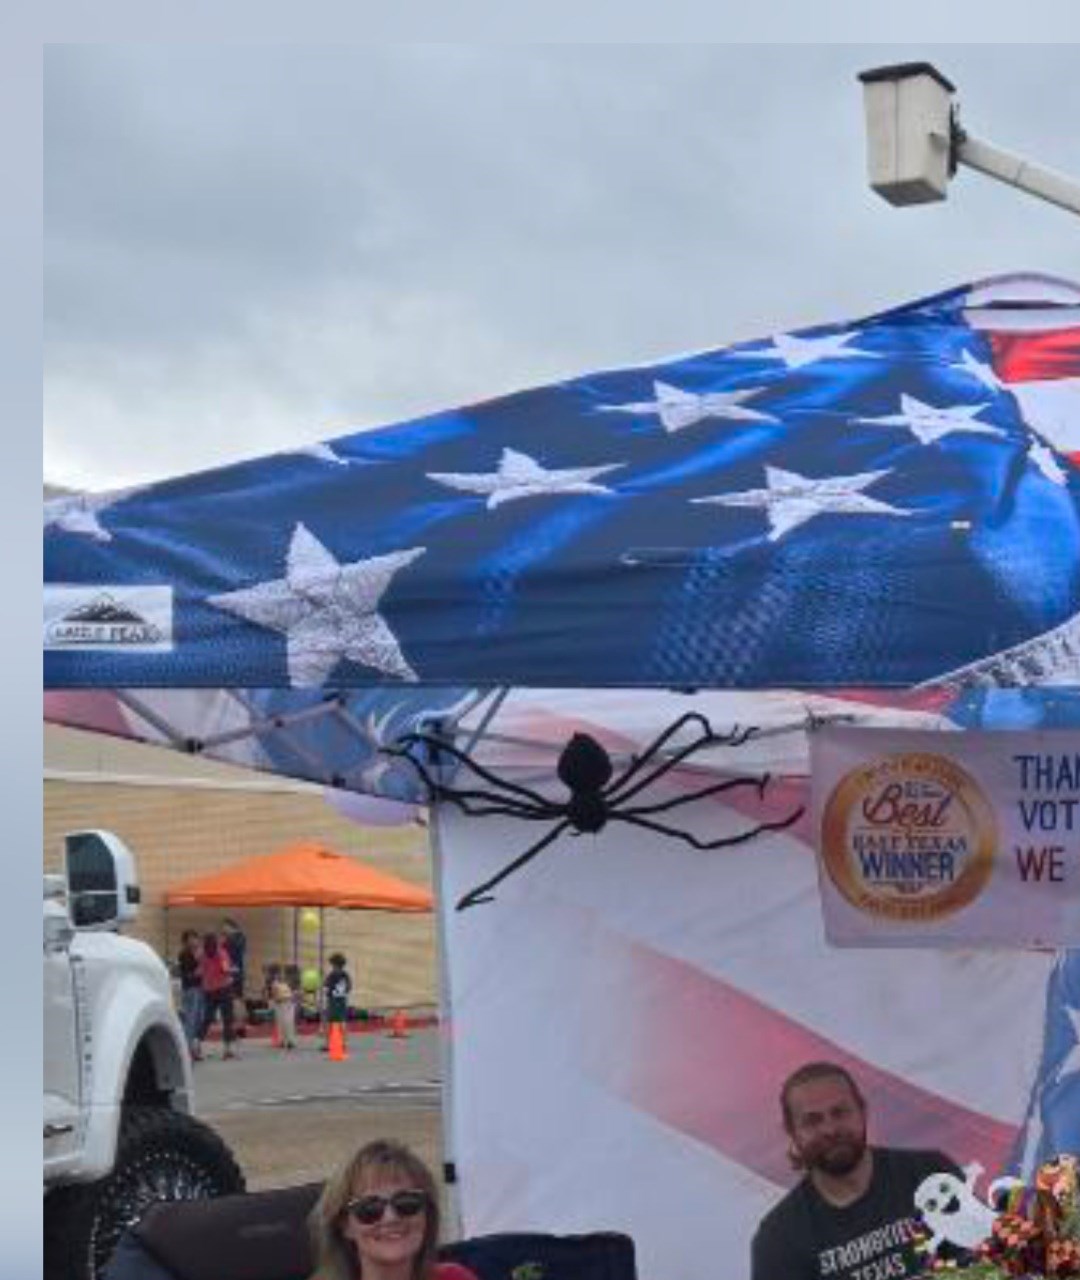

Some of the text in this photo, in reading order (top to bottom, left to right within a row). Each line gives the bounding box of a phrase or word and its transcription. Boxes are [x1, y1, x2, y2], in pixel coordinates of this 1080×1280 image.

[863, 783, 953, 826] Best
[859, 852, 954, 881] WINNER
[1017, 846, 1063, 882] WE
